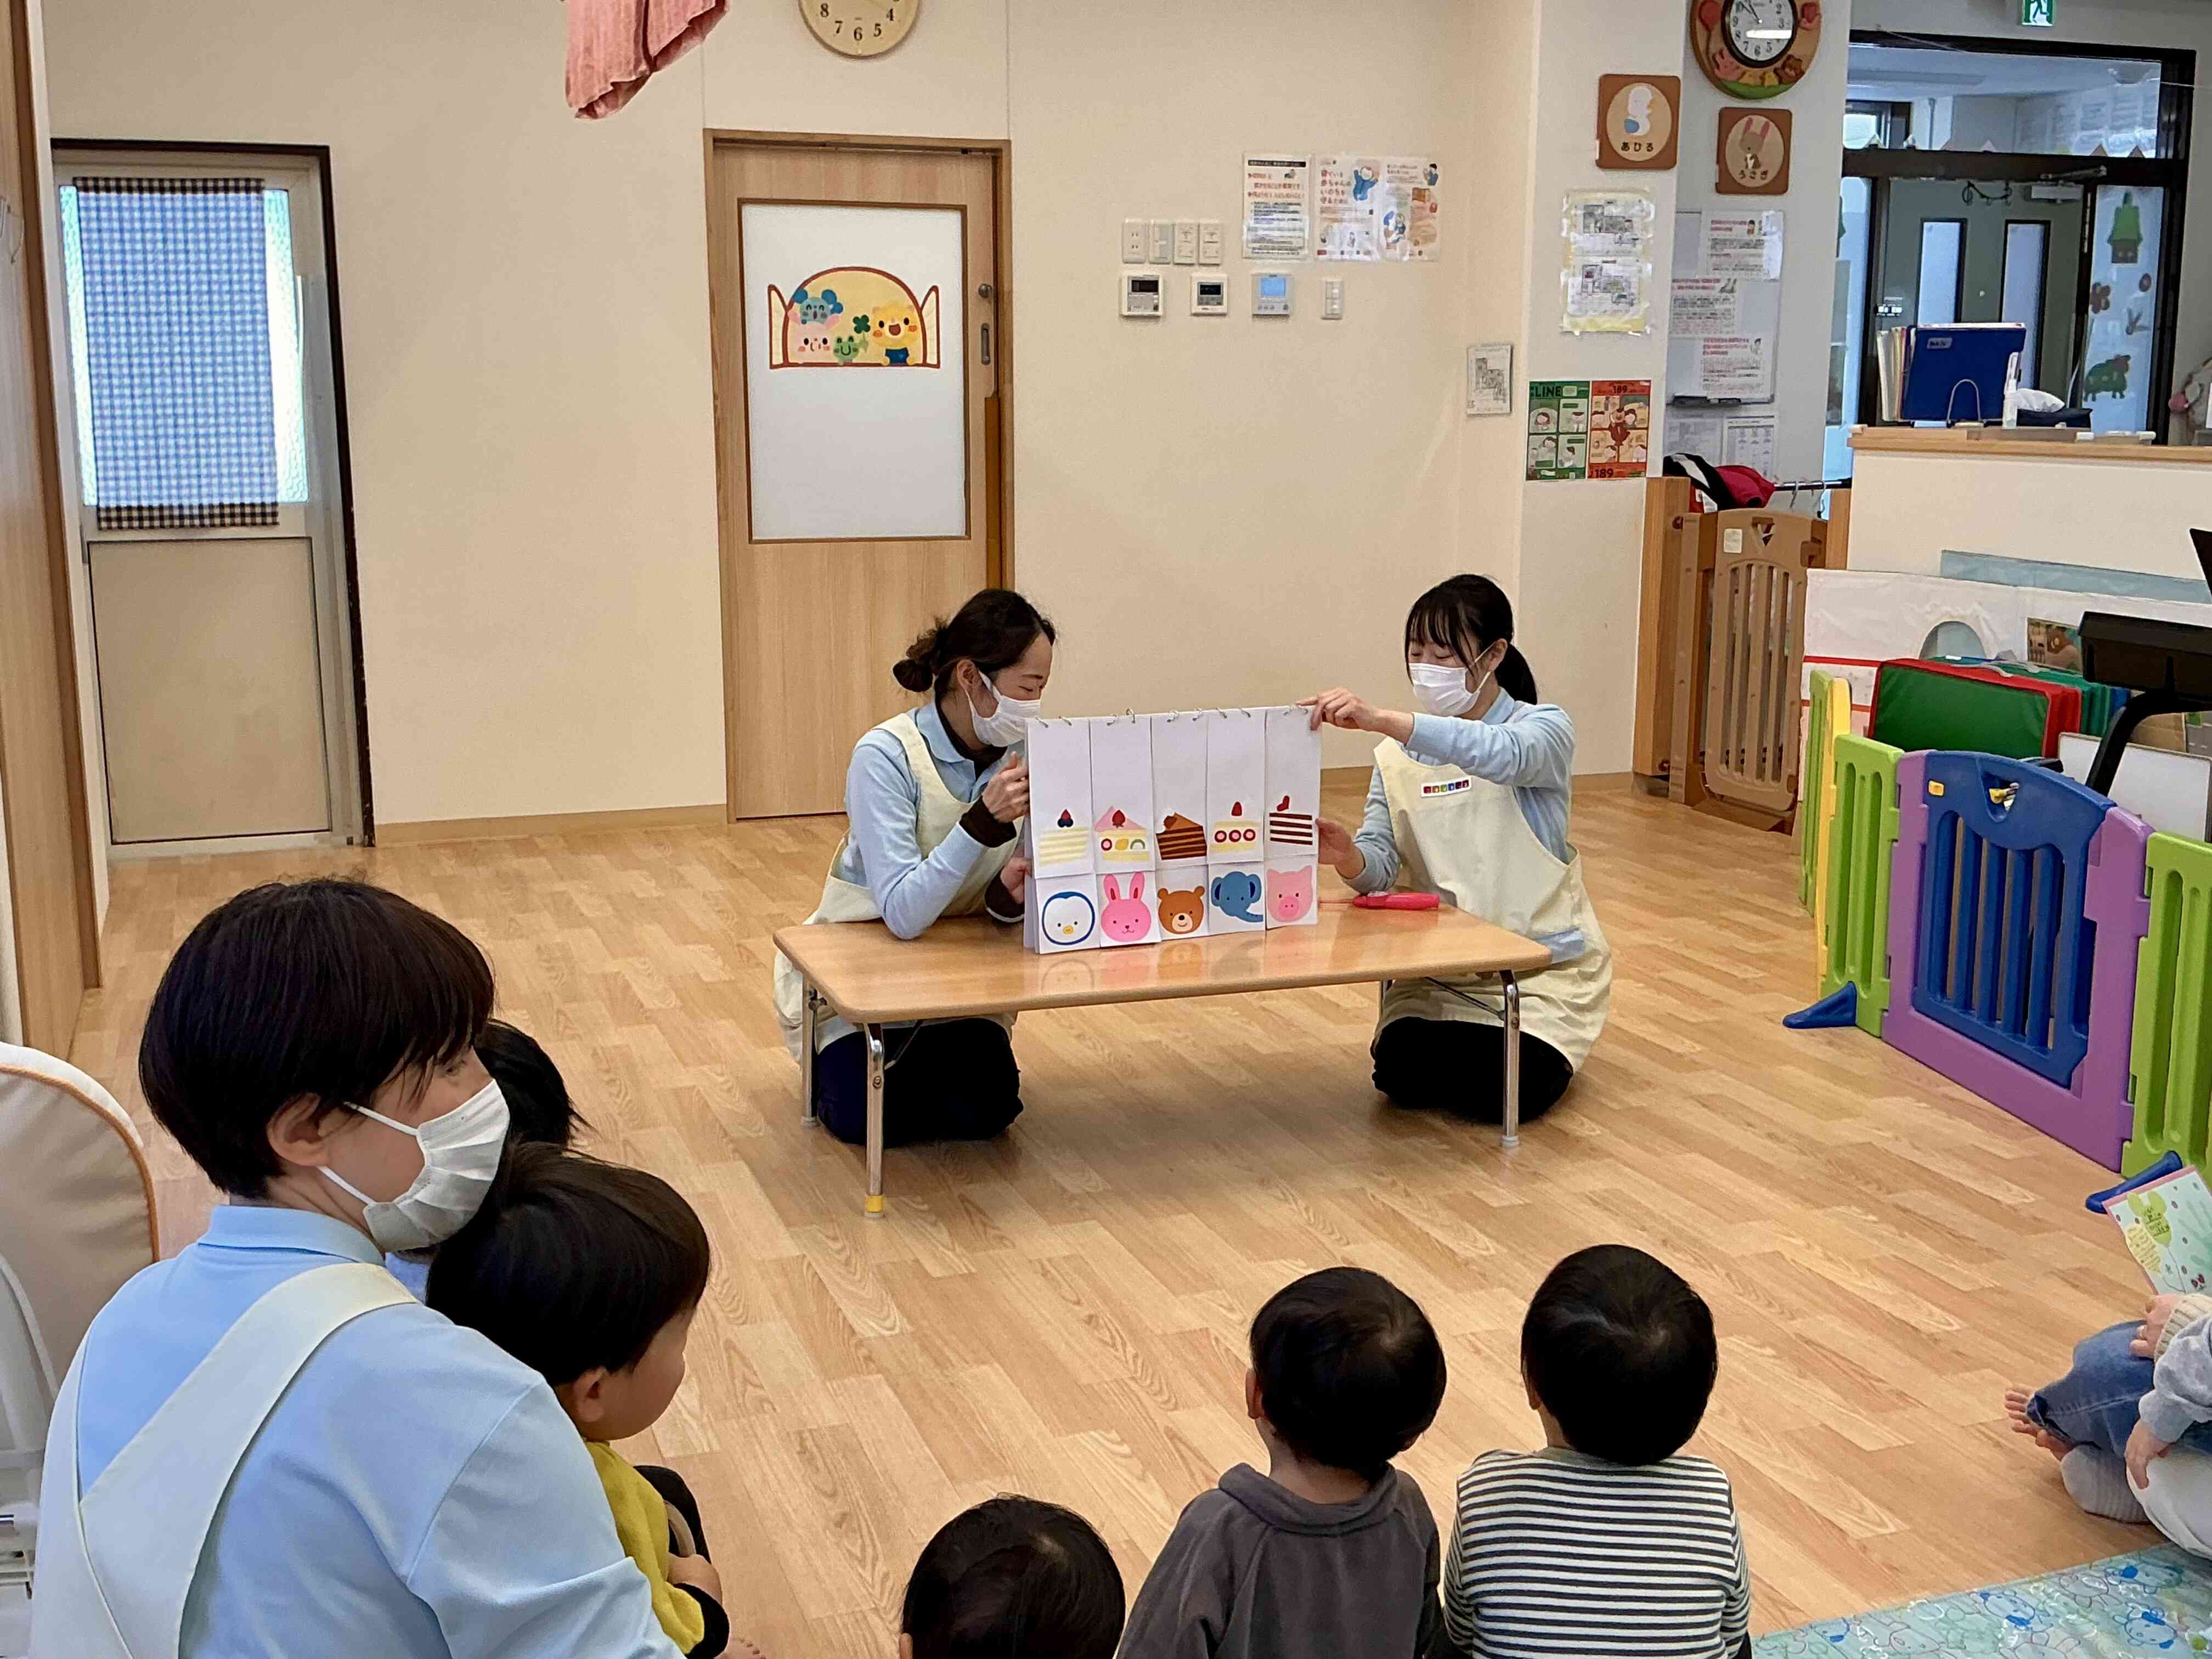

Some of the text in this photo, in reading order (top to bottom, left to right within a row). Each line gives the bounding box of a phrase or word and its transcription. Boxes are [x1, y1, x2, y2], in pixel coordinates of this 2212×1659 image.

[820, 3, 829, 18] 8
[885, 8, 894, 21] 4
[1776, 3, 1782, 14] 2
[1733, 15, 1739, 27] 9
[834, 20, 843, 35] 7
[873, 23, 882, 37] 5
[854, 27, 863, 41] 6
[1743, 41, 1749, 52] 7
[1754, 44, 1760, 57] 6
[1621, 142, 1654, 152] あひる
[1738, 170, 1769, 180] うさぎ
[1613, 385, 1628, 393] 189
[1594, 468, 1613, 478] 189
